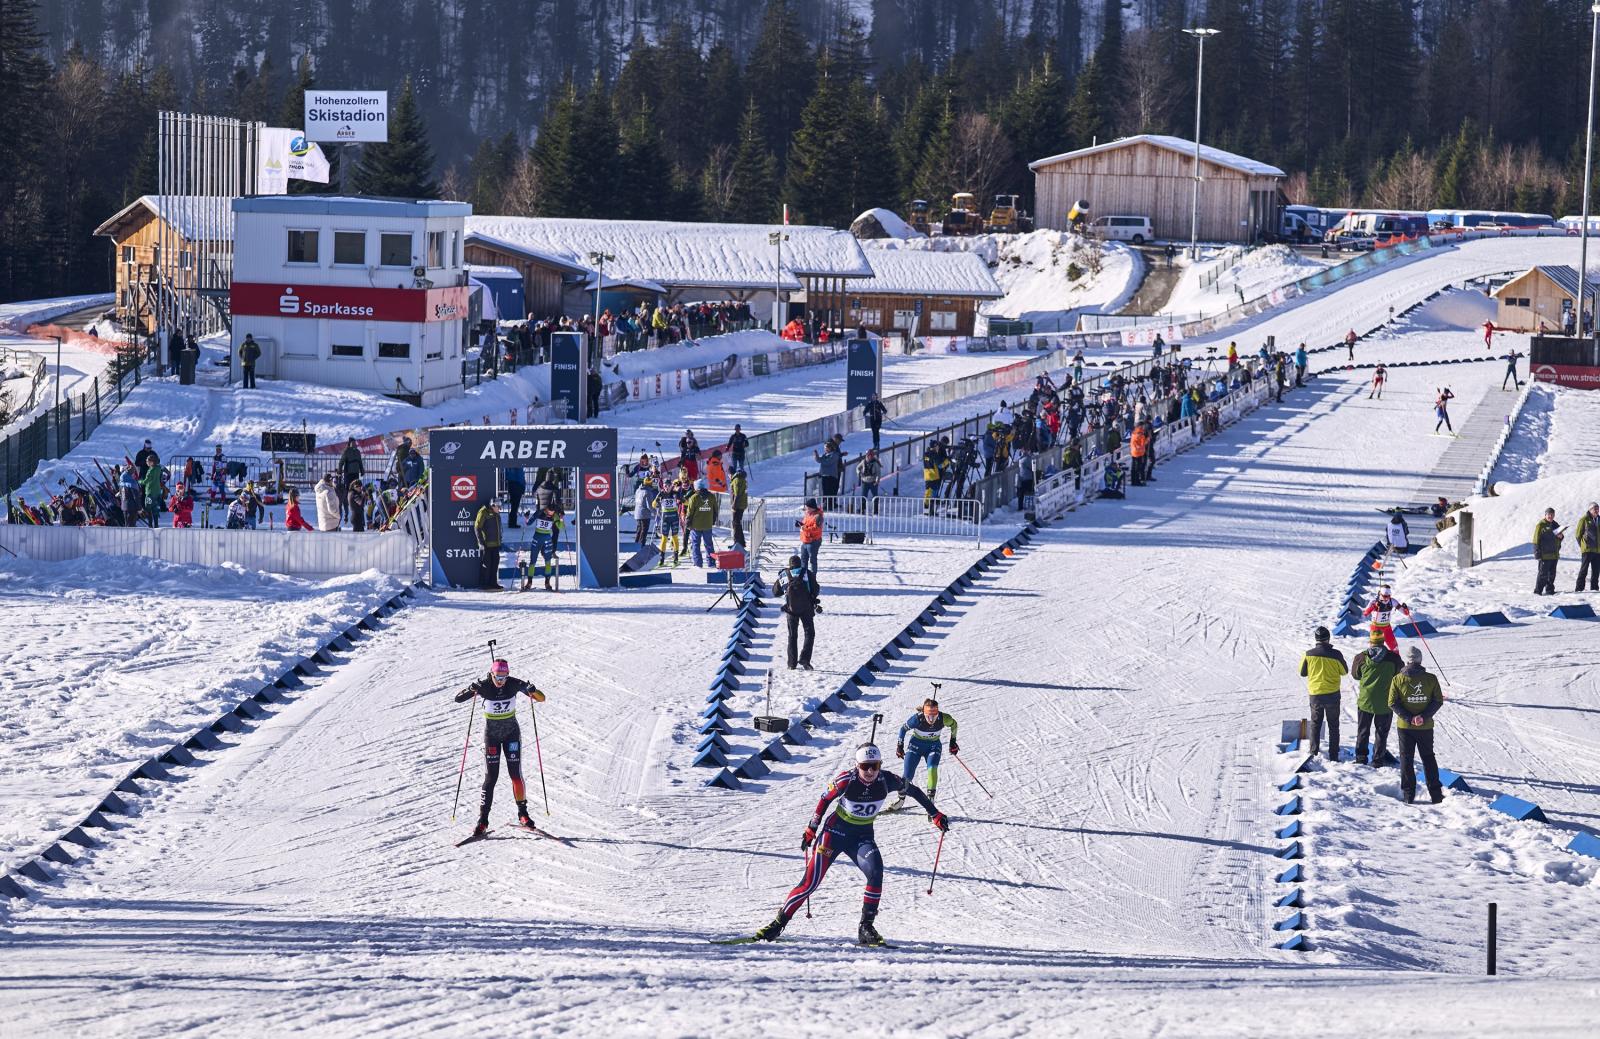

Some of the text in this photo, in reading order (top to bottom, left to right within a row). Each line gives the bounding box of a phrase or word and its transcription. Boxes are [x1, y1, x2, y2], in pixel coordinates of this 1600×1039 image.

[314, 96, 379, 105] Hohenzollern
[308, 109, 385, 121] Skistadion
[304, 302, 374, 316] Sparkasse
[553, 363, 577, 371] FINISH
[479, 440, 567, 460] ARBER
[446, 548, 481, 558] START
[493, 701, 511, 711] 37
[852, 803, 877, 815] 20
